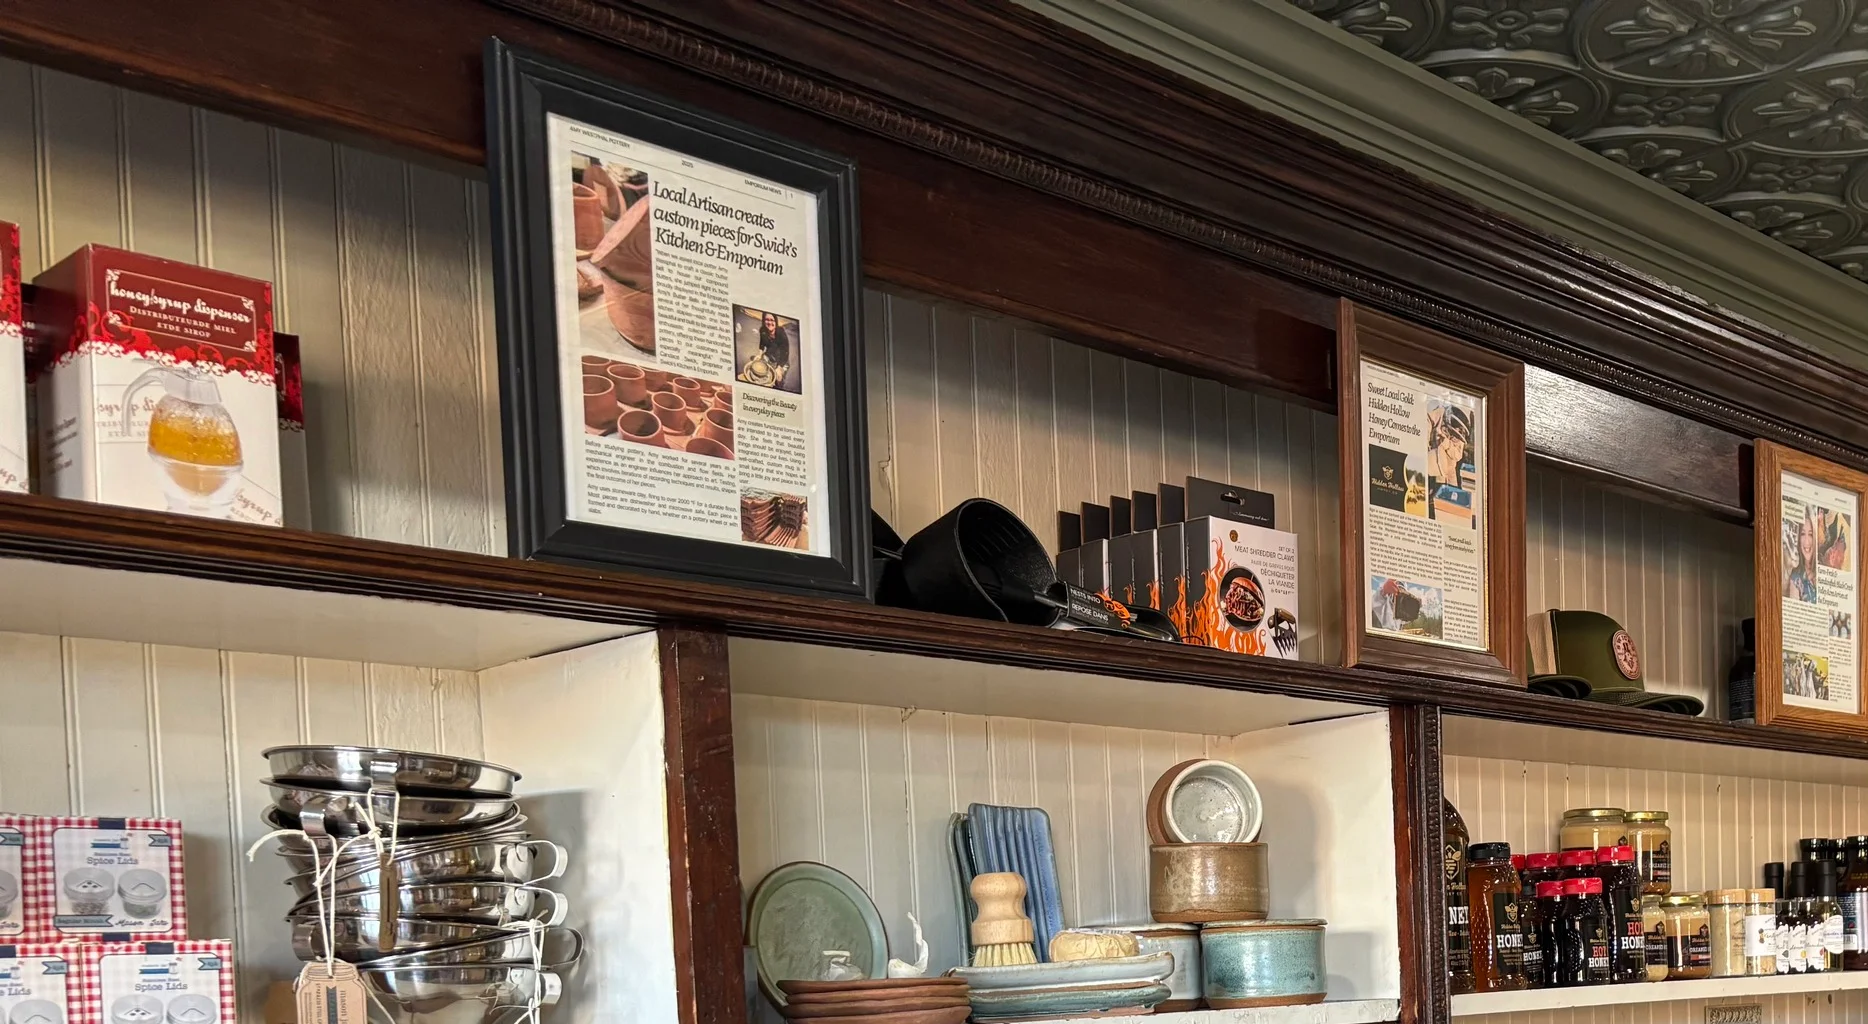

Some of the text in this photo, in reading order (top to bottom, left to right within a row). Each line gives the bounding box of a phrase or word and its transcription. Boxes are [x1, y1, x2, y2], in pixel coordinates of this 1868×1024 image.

[768, 186, 782, 196] NEWS
[653, 180, 775, 231] Local Artisan creates
[653, 209, 798, 259] custom pieces for Swick's
[655, 226, 784, 276] Kitchen & Emporium
[193, 297, 252, 324] dispenser
[183, 327, 212, 339] SIROP
[213, 323, 238, 335] MIEL
[1367, 382, 1385, 397] Sweet
[1384, 386, 1400, 401] Local
[742, 392, 798, 412] Discovering the Beauty
[1368, 397, 1411, 420] Hidden Hollow
[748, 405, 771, 418] everyday
[770, 409, 786, 418] pieces
[1368, 411, 1388, 430] Honey
[1387, 418, 1407, 433] Comes
[1411, 424, 1421, 437] the
[1369, 427, 1400, 446] Emporium
[585, 448, 612, 458] mechanical
[615, 453, 636, 462] engineer
[657, 461, 685, 471] combustion
[604, 444, 625, 453] studying
[648, 451, 659, 459] Amy
[1234, 545, 1295, 562] MEAT SHREDDER CLAWS
[1268, 578, 1295, 590] LA VIANDE
[1070, 588, 1101, 604] NESTS INTO
[1071, 602, 1109, 621] REPOSE DANS
[87, 856, 139, 866] Spice Lids
[115, 918, 145, 927] Mason
[7, 988, 32, 996] Lids
[134, 982, 189, 992] Spice Lids
[339, 990, 348, 1017] mason
